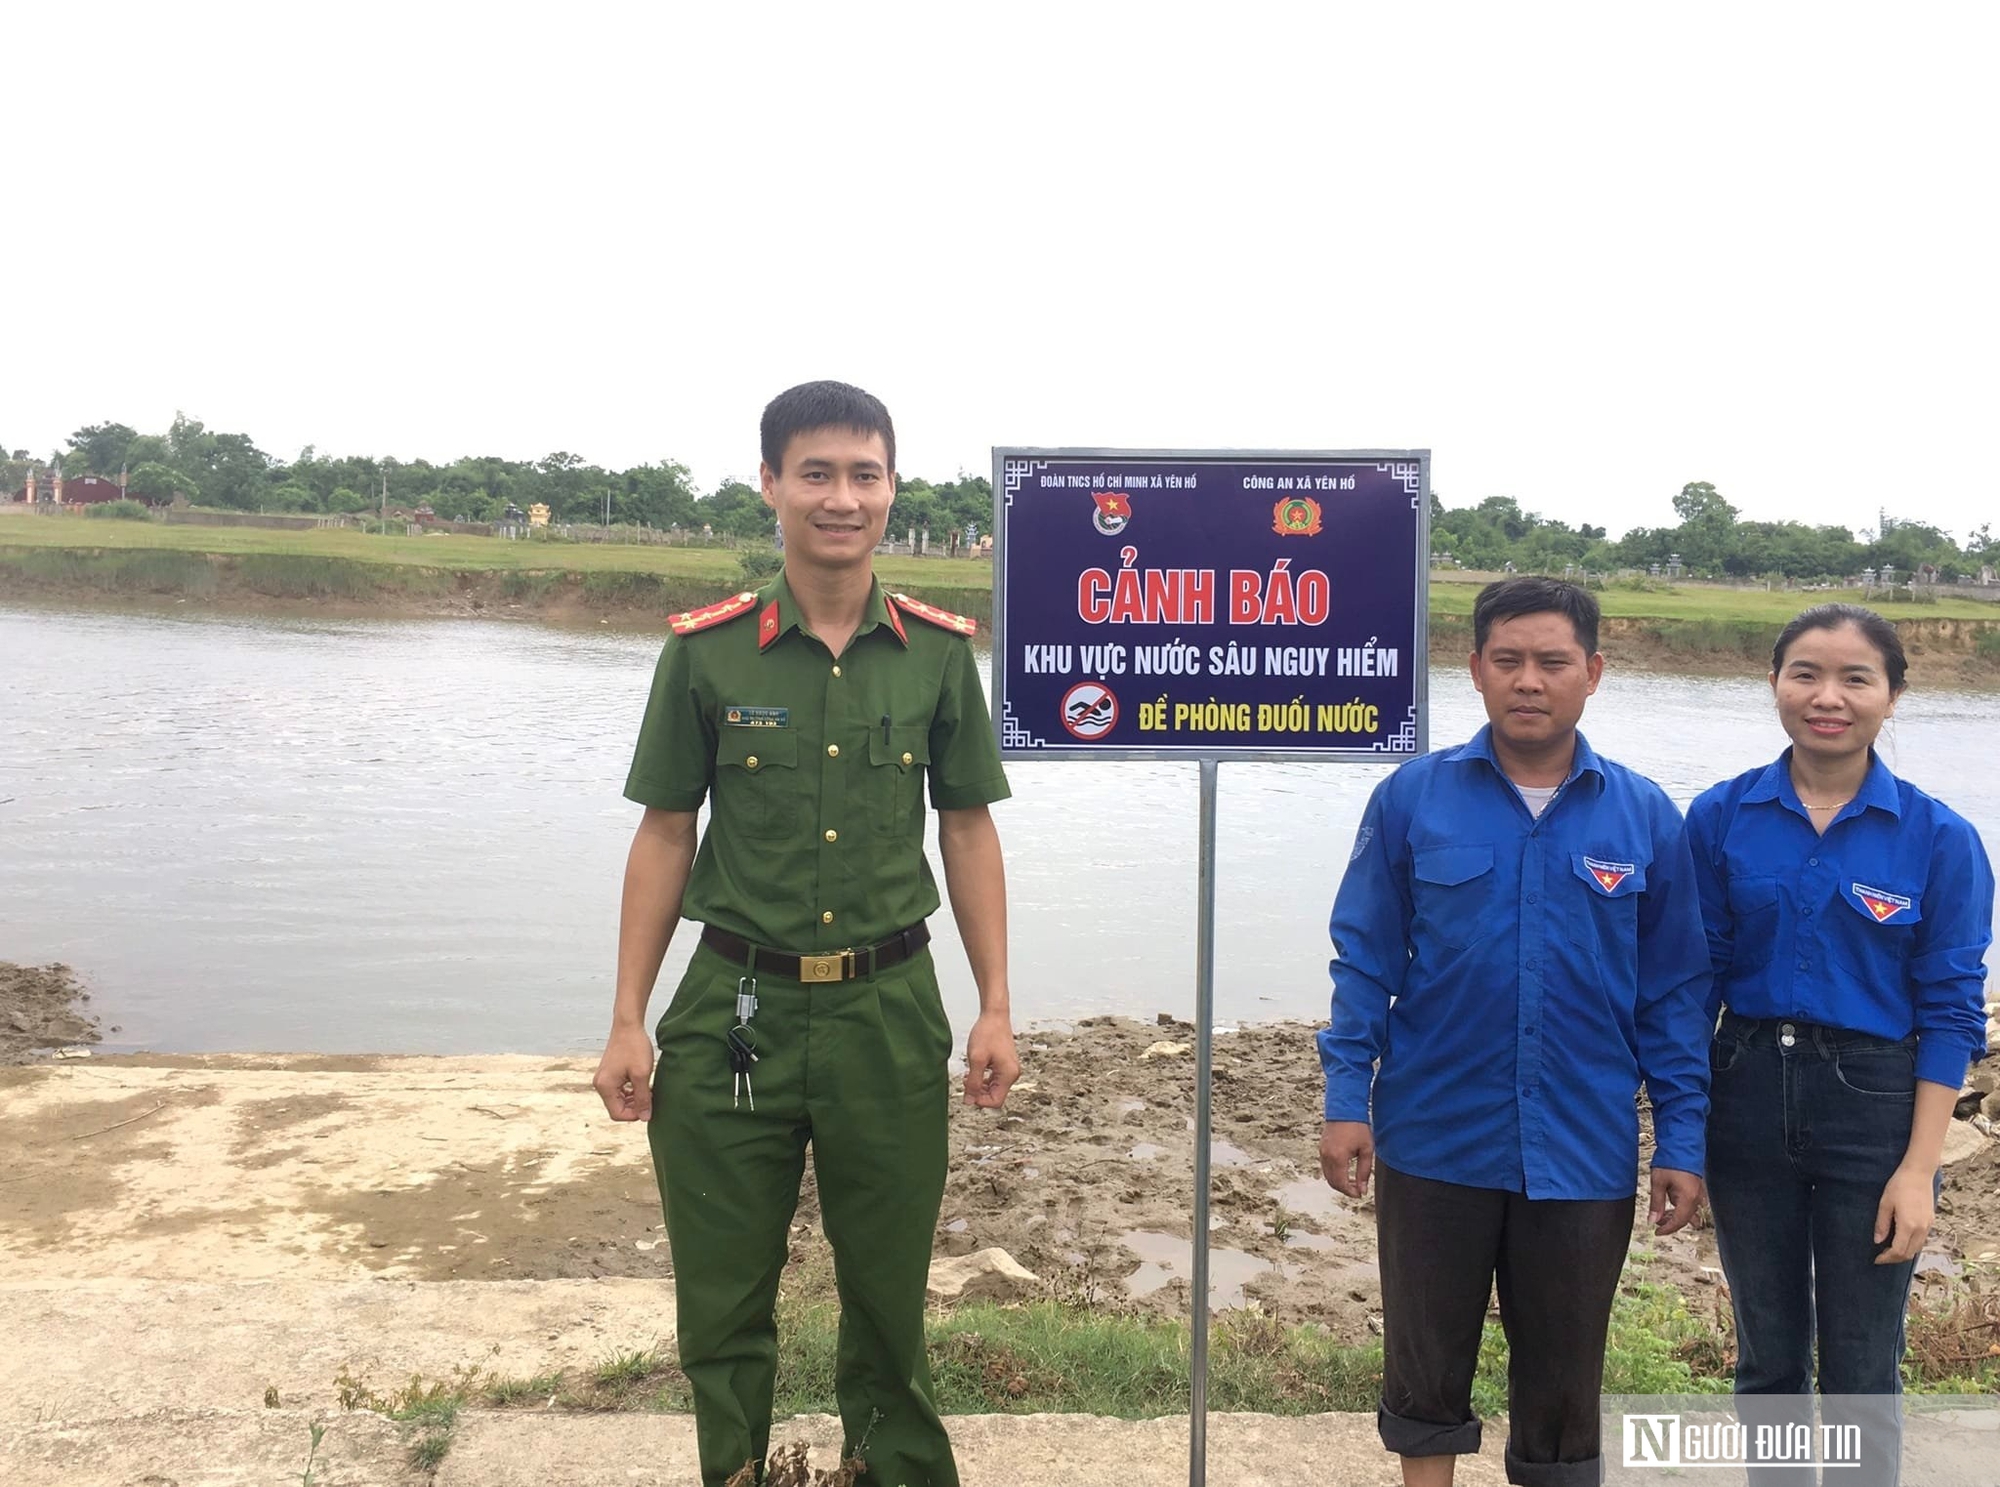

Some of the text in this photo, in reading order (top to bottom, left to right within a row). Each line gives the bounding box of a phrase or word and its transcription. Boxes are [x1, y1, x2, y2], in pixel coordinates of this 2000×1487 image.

[1041, 473, 1065, 488] ĐOÀN
[1068, 476, 1090, 488] TNCS
[1107, 474, 1122, 488] CHÍ
[1125, 477, 1147, 488] MINH
[1151, 474, 1162, 488] XÃ
[1165, 475, 1182, 488] YÊN
[1243, 475, 1274, 489] CÔNG
[1277, 478, 1293, 489] AN
[1297, 475, 1311, 489] XÃ
[1315, 476, 1336, 489] YÊN
[1078, 546, 1330, 626] CẢNH BÁO
[1024, 637, 1398, 680] KHU VỰC NƯỚC SÂU NGUY HIỂM
[1139, 694, 1378, 733] ĐỀ PHÒNG ĐUỐI NƯỚC
